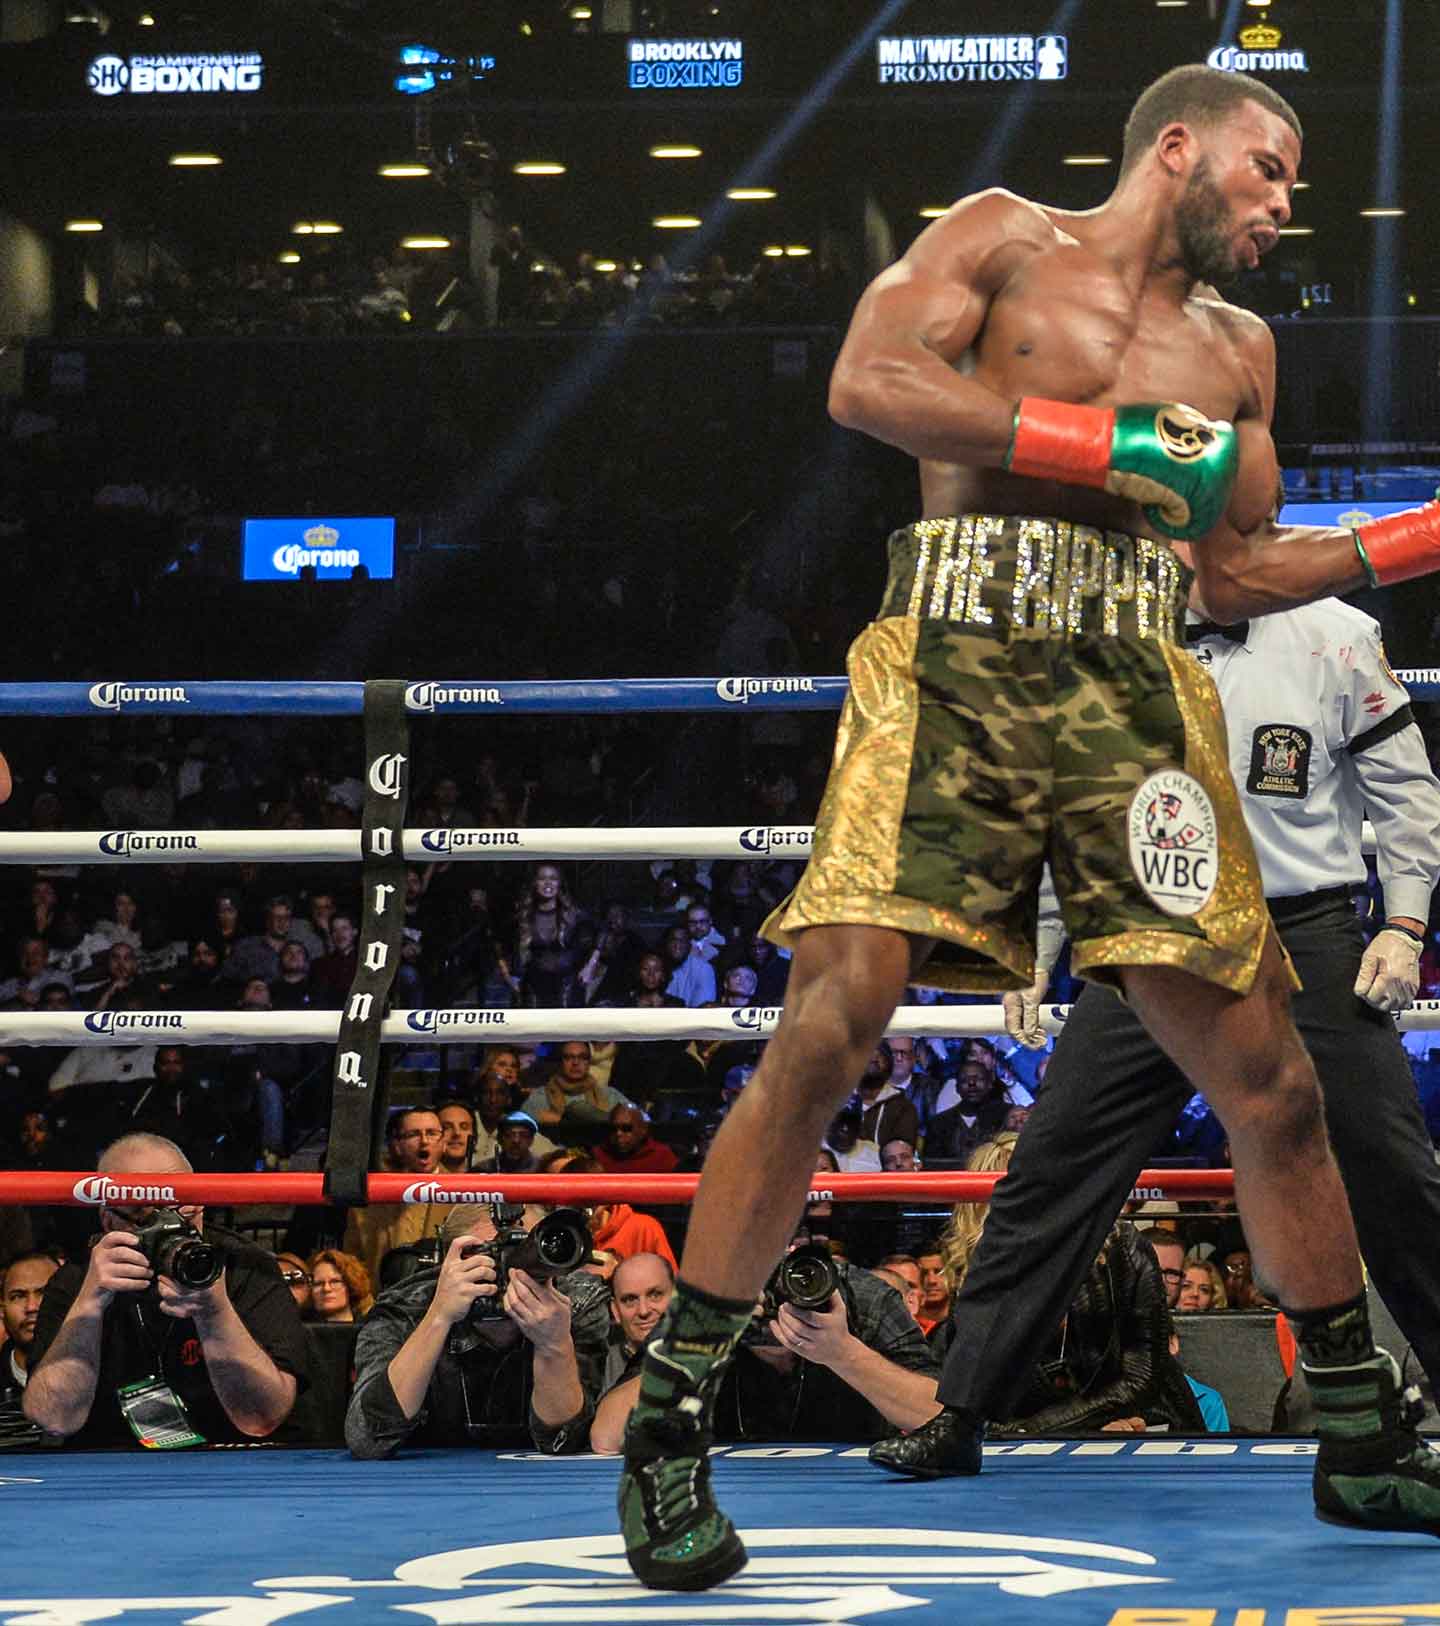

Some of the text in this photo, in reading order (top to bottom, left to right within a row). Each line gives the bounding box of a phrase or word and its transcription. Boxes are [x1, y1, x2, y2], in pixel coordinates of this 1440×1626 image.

[131, 56, 262, 68] CHAMPIONSHIP
[629, 41, 742, 60] BROOKLYN
[878, 39, 1034, 64] MAYWEATHER
[1207, 47, 1309, 73] Corona
[131, 67, 261, 91] BOXING
[630, 61, 742, 88] BOXING
[879, 62, 1036, 82] PROMOTIONS
[273, 545, 361, 575] Corona
[905, 516, 1003, 625] THE
[89, 681, 190, 711] Corona
[405, 682, 504, 712] Corona
[717, 677, 818, 704] Corona
[1262, 775, 1296, 785] ATHLETIC
[1131, 773, 1218, 849] WORLD CHAMPION
[99, 831, 201, 857] Corona
[422, 829, 524, 854] Corona
[1141, 850, 1210, 891] WBC
[338, 753, 407, 1084] Corona
[84, 1011, 186, 1036] Corona
[406, 1009, 508, 1034] Corona
[73, 1176, 177, 1204] Corona
[402, 1181, 504, 1204] Corona
